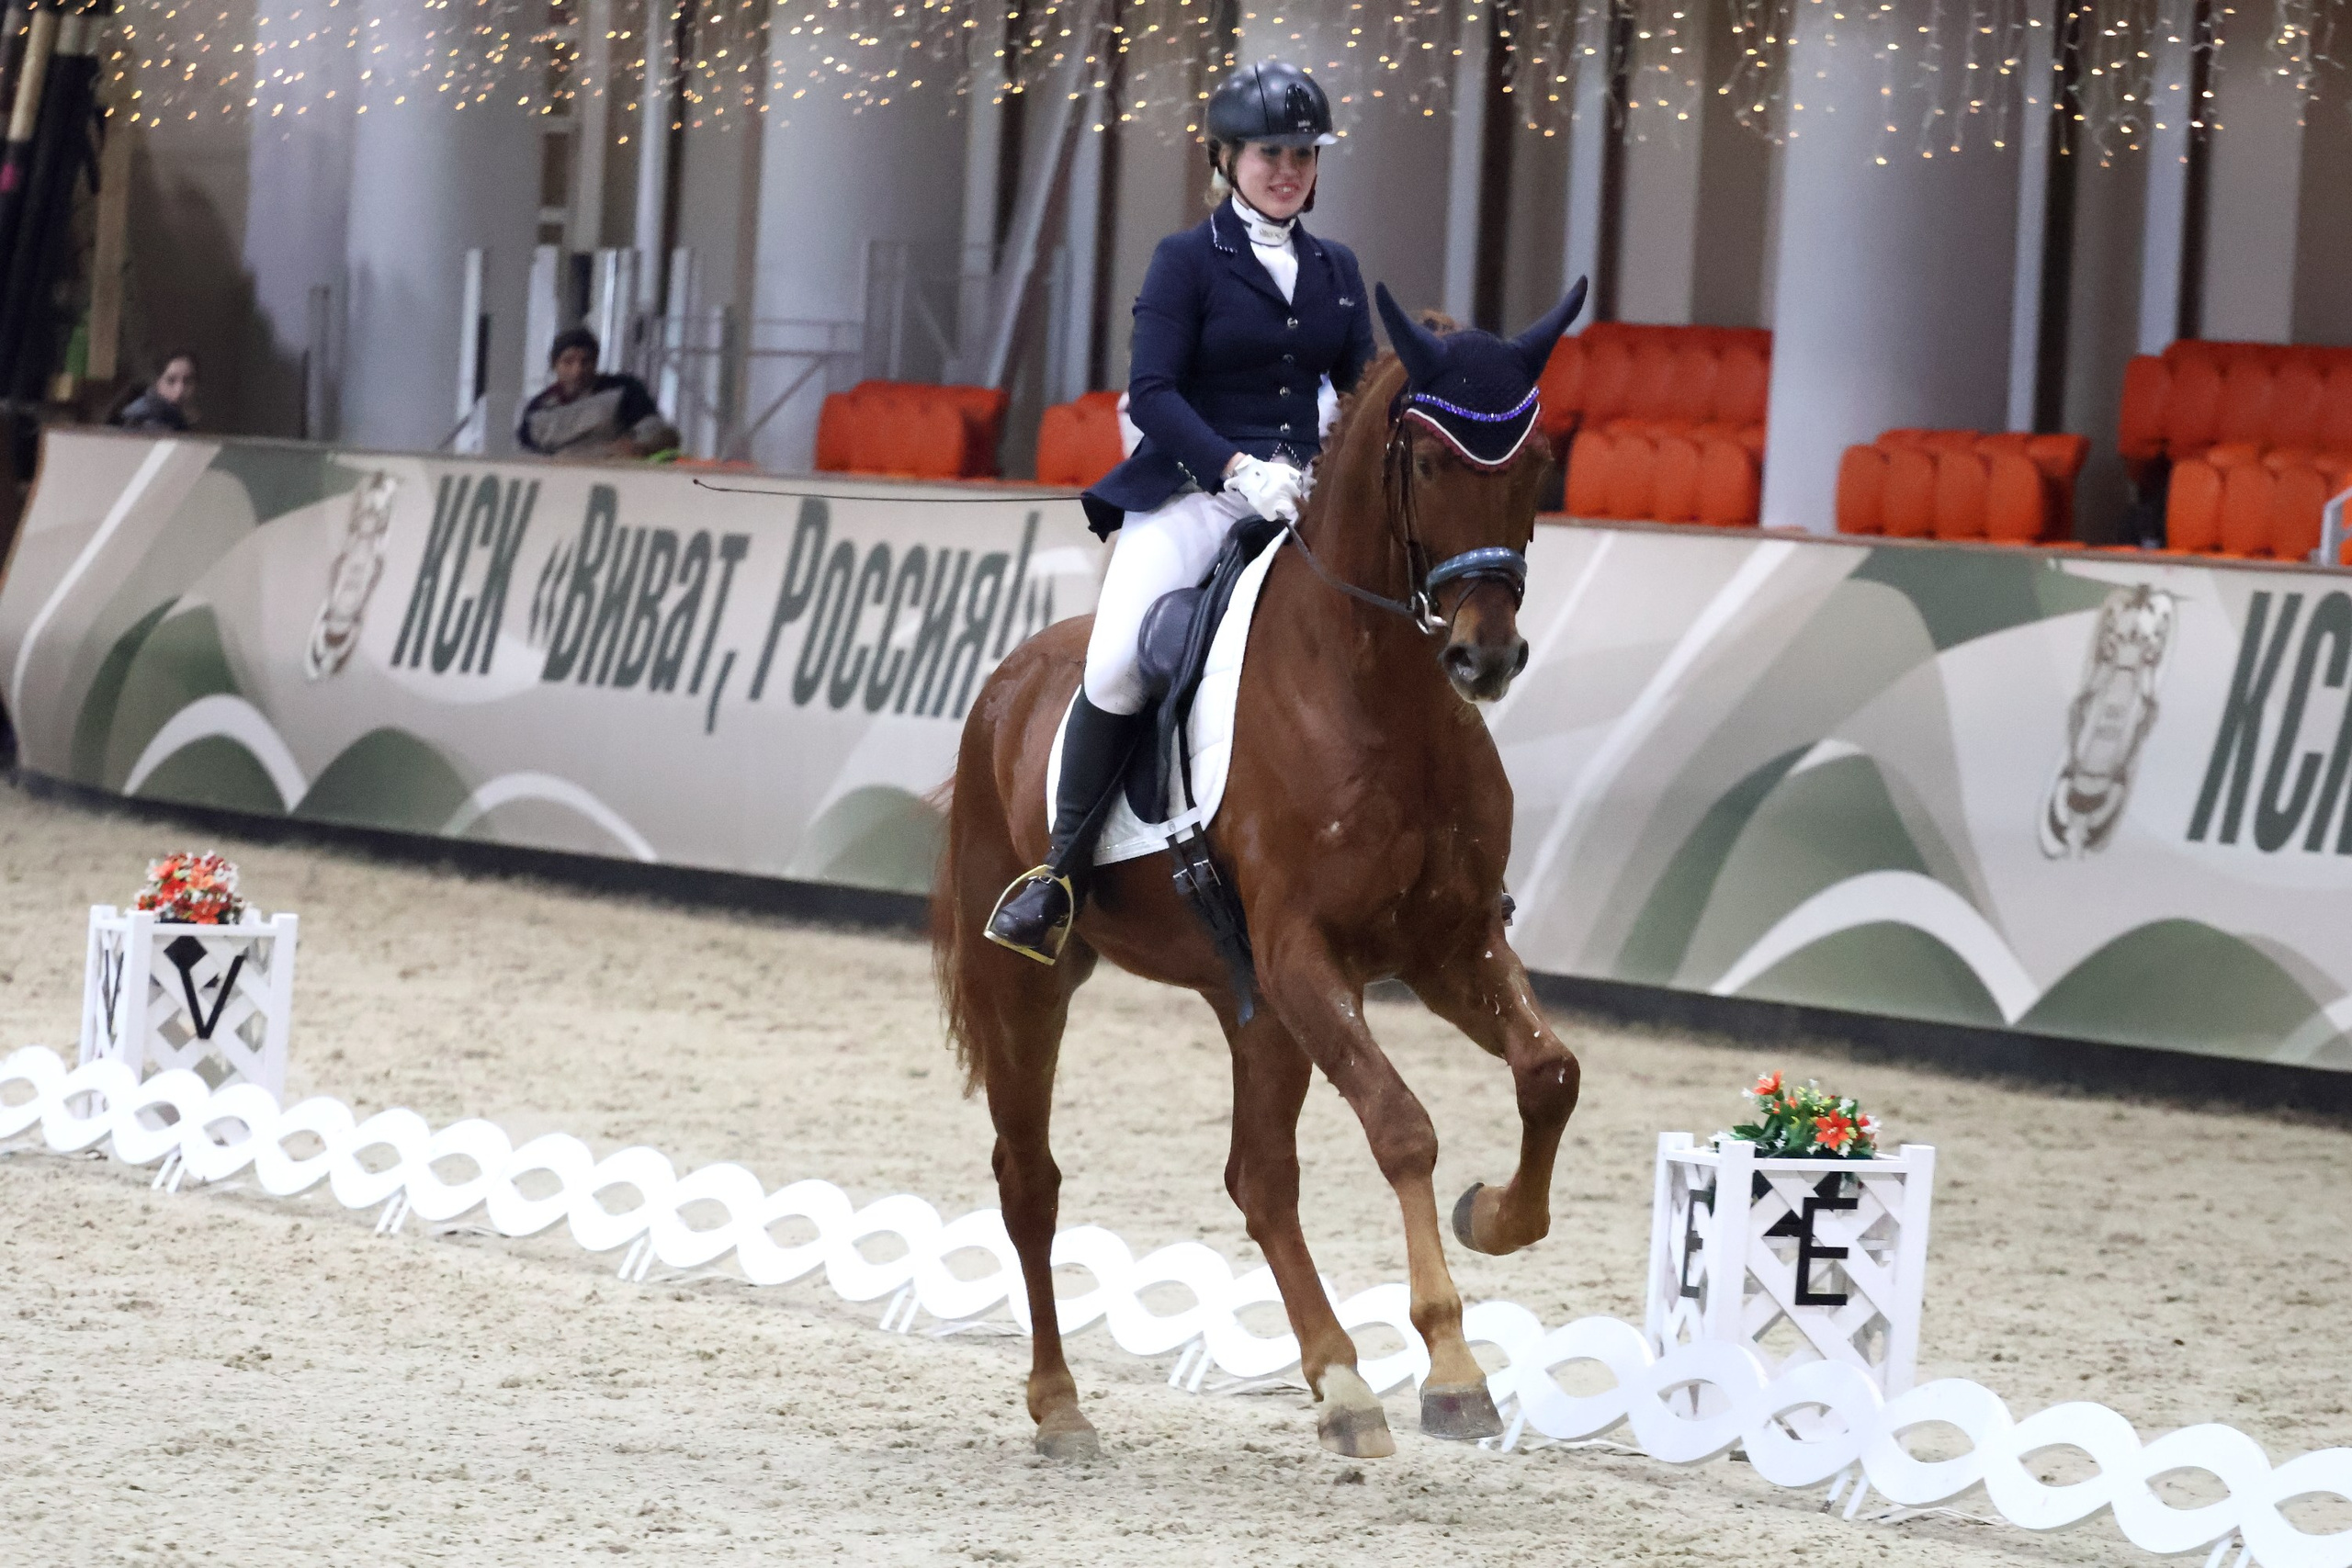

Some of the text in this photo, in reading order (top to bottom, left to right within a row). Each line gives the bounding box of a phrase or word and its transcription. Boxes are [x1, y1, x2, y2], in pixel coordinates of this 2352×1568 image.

[390, 473, 541, 675] КСК
[529, 482, 751, 735] «Виват,
[175, 952, 245, 1040] V
[1795, 1197, 1858, 1305] E
